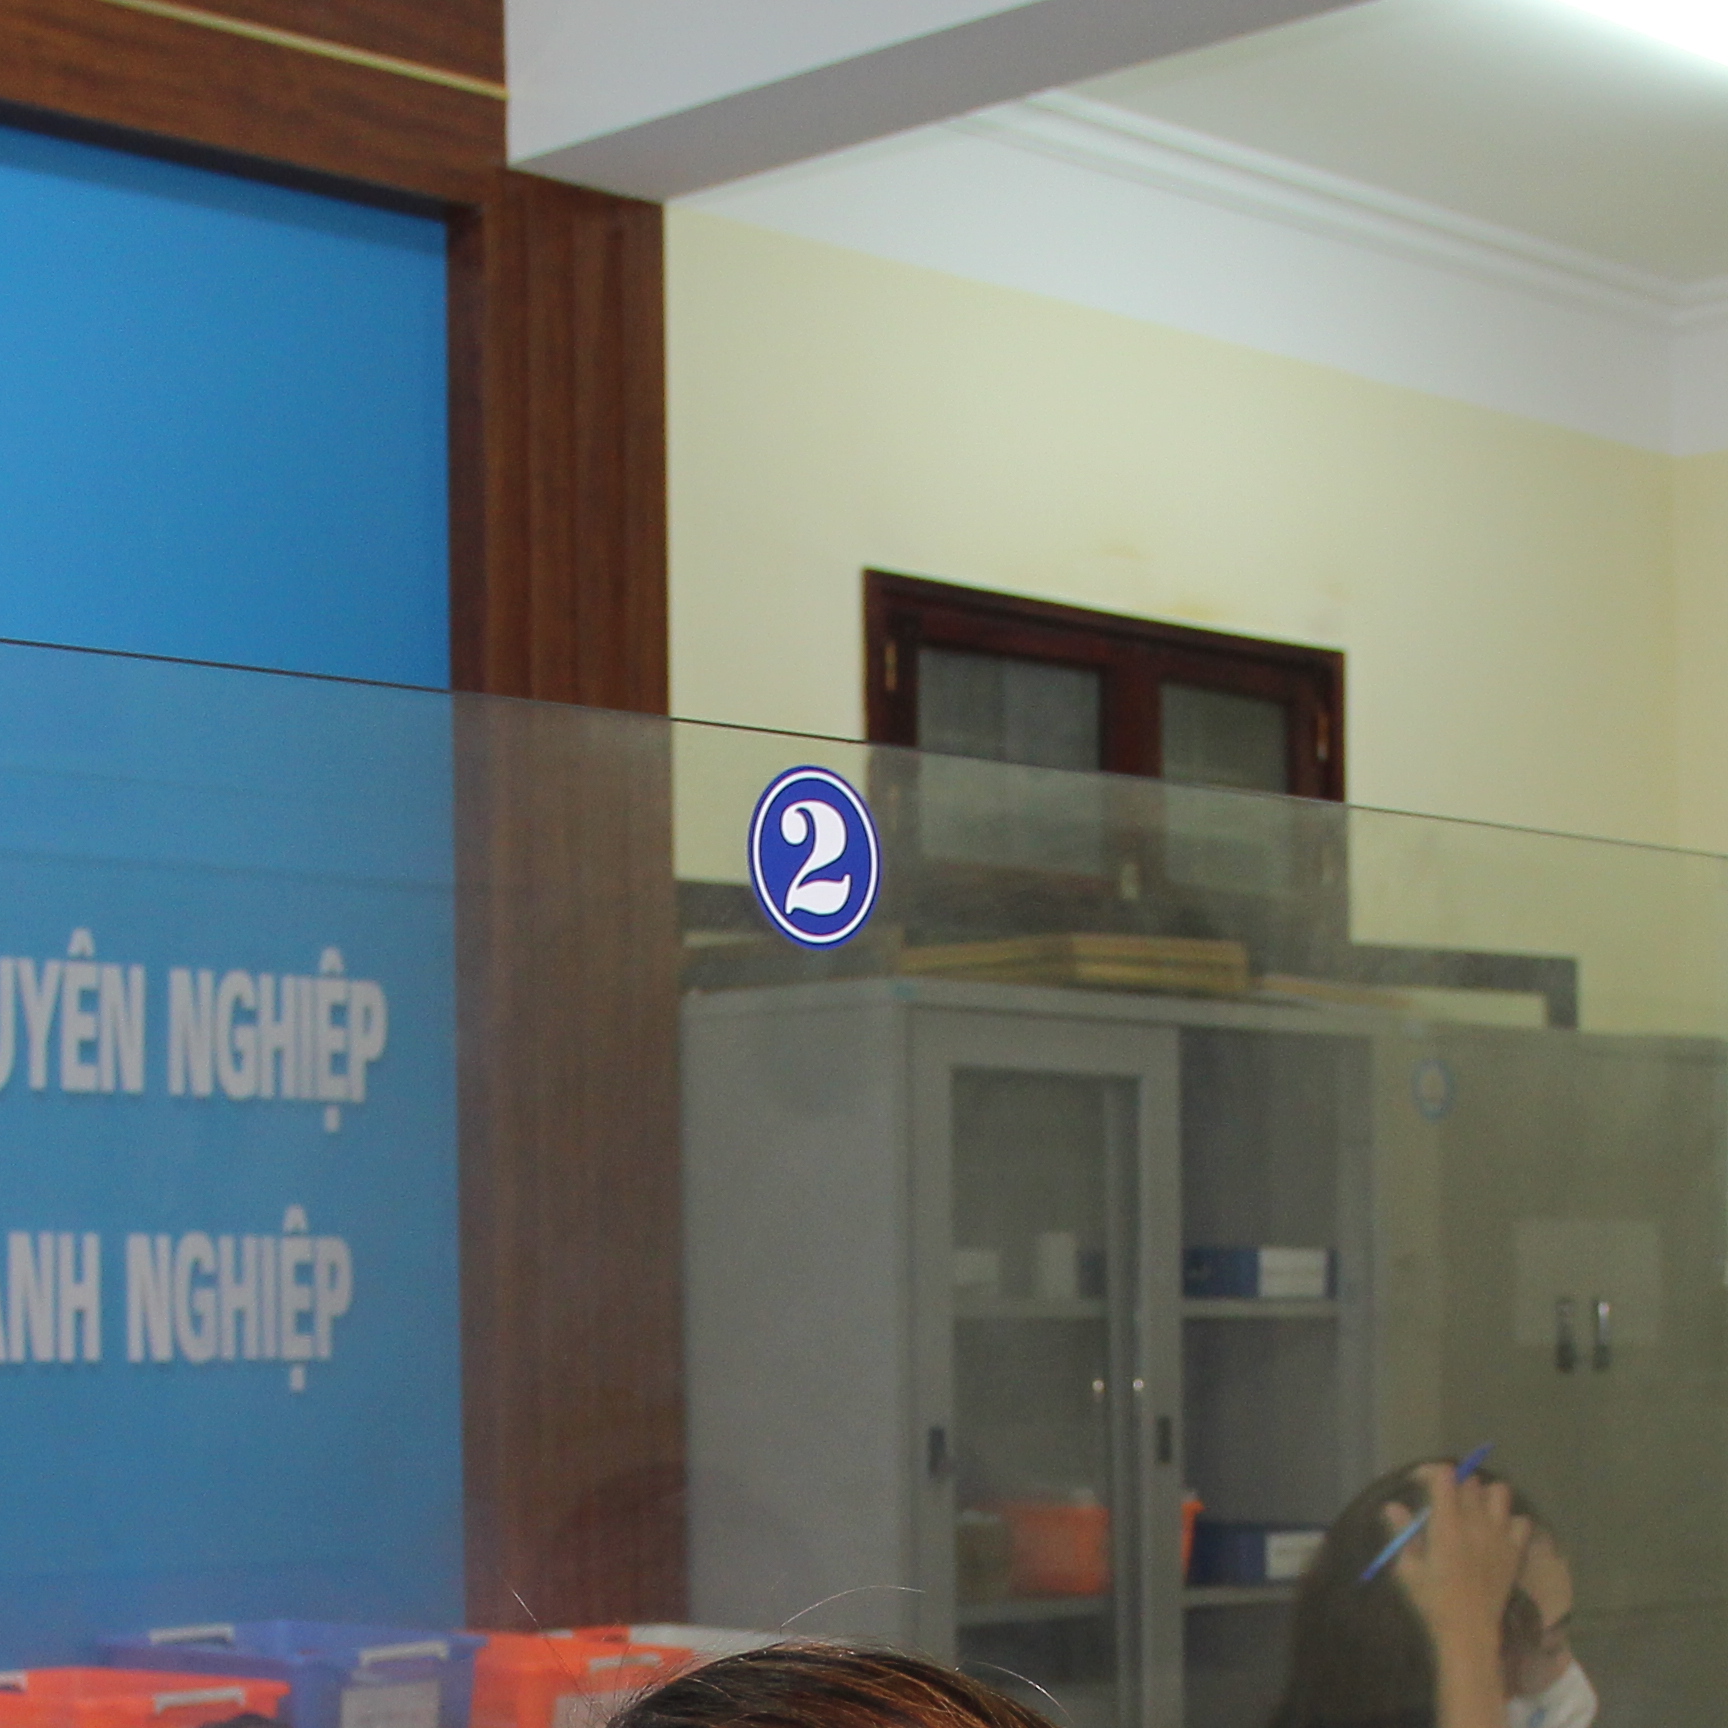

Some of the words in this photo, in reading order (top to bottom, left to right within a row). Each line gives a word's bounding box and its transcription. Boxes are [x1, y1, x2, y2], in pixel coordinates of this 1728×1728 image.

[780, 798, 851, 915] 2
[168, 947, 388, 1132] NGHIỆP
[125, 1206, 353, 1391] NGHIỆP
